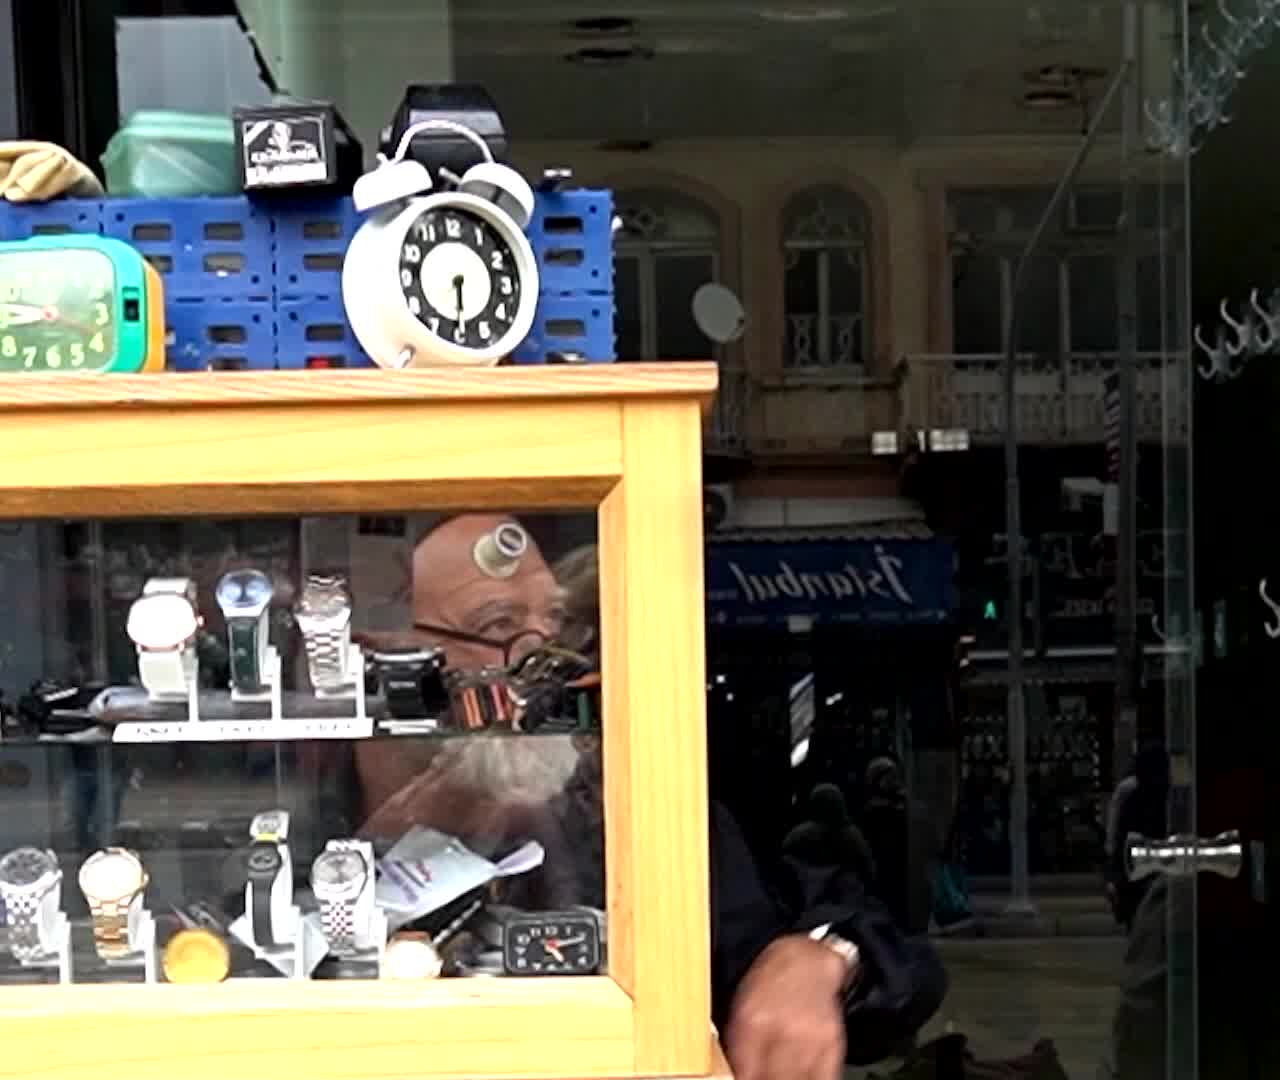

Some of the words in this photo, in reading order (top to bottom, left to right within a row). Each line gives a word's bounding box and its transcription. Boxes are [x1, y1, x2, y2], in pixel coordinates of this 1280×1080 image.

[421, 224, 435, 242] 11
[445, 215, 461, 238] 12
[474, 227, 483, 246] 1
[403, 244, 421, 263] 10
[491, 250, 503, 270] 2
[499, 276, 512, 294] 3
[95, 302, 109, 325] 3
[494, 302, 506, 318] 4
[1, 335, 17, 357] 8
[88, 332, 105, 352] 4
[23, 346, 37, 368] 7
[46, 345, 61, 368] 6
[70, 343, 85, 366] 5
